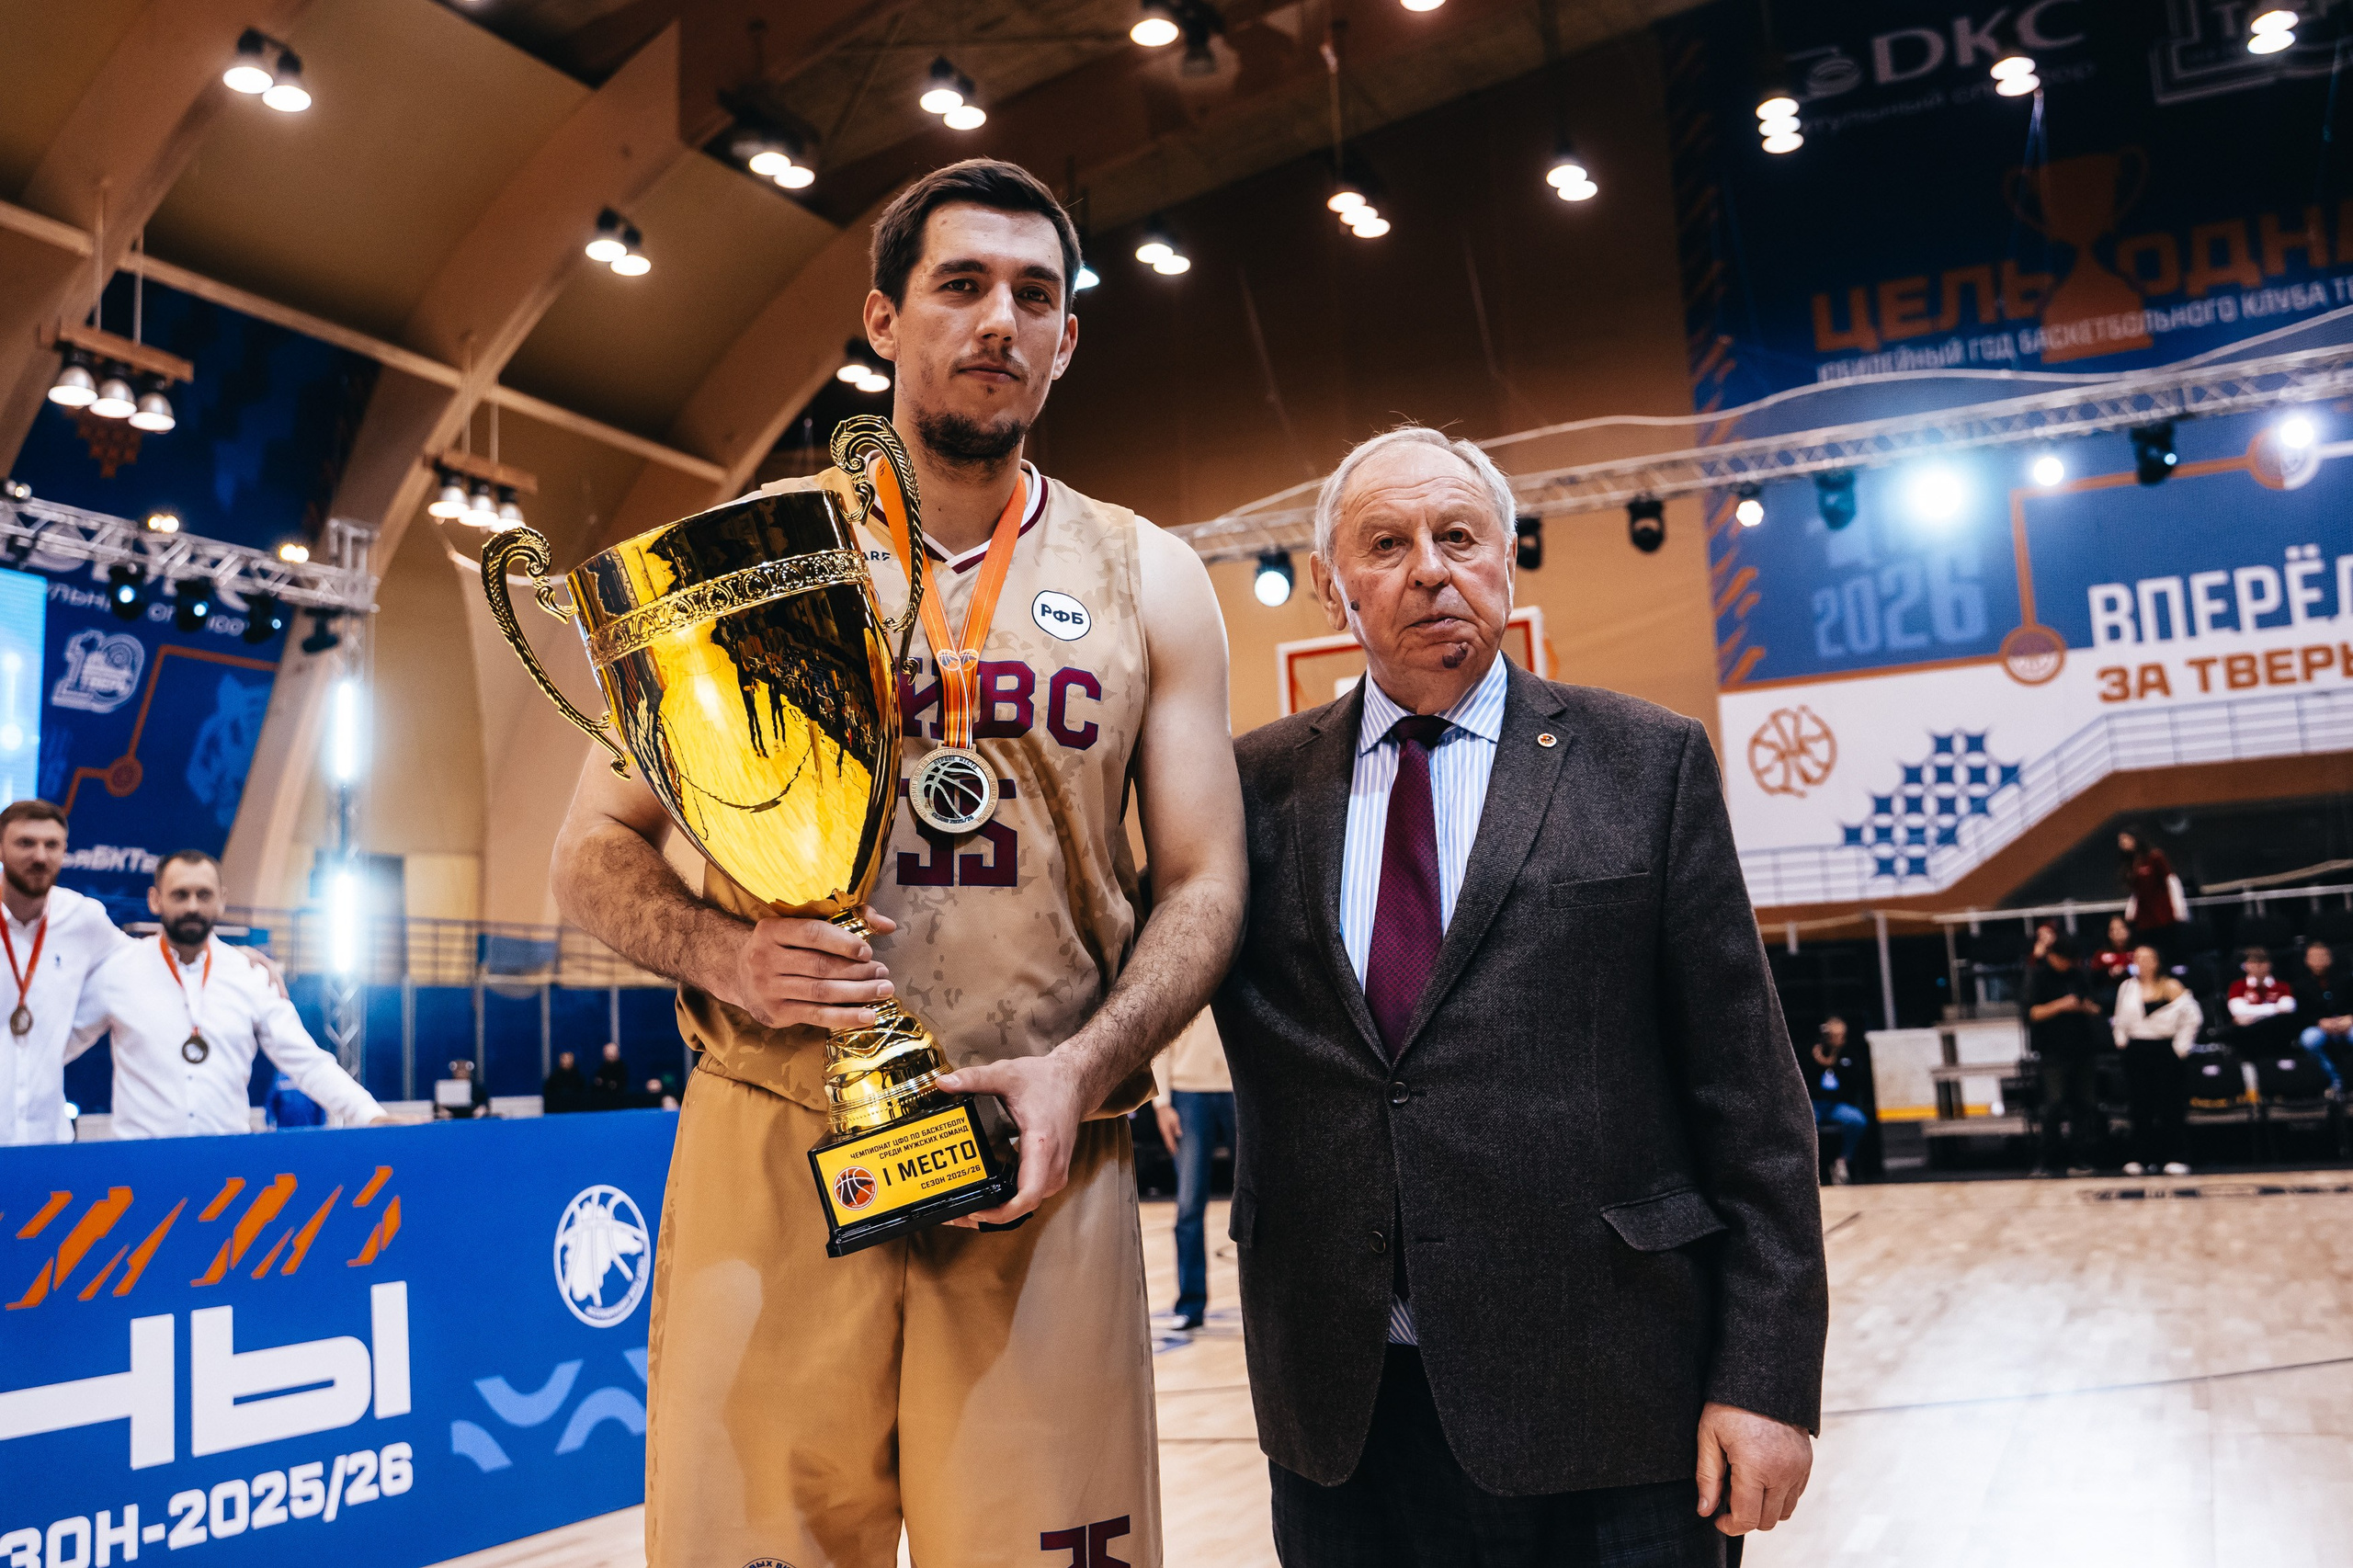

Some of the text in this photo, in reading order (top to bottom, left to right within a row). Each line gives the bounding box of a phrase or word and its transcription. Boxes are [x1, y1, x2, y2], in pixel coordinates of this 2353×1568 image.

[1870, 0, 2086, 84] DKC
[1811, 260, 2055, 354] ЦЕЛЬ
[1968, 332, 2017, 361] ГОД
[2241, 279, 2328, 320] КЛУБА
[1040, 603, 1085, 625] РФБ
[1813, 540, 1988, 659] 2026
[2097, 663, 2172, 704] ЗА
[850, 1117, 965, 1159] ЧЕМПИОНАТ ЦФО ПО БАСКЕТБОЛУ
[879, 1125, 969, 1160] СРЕДИ МУЖСКИХ КОМАНД
[897, 1140, 977, 1182] МЕСТО
[921, 1165, 981, 1189] СЕЗОН 2025/26
